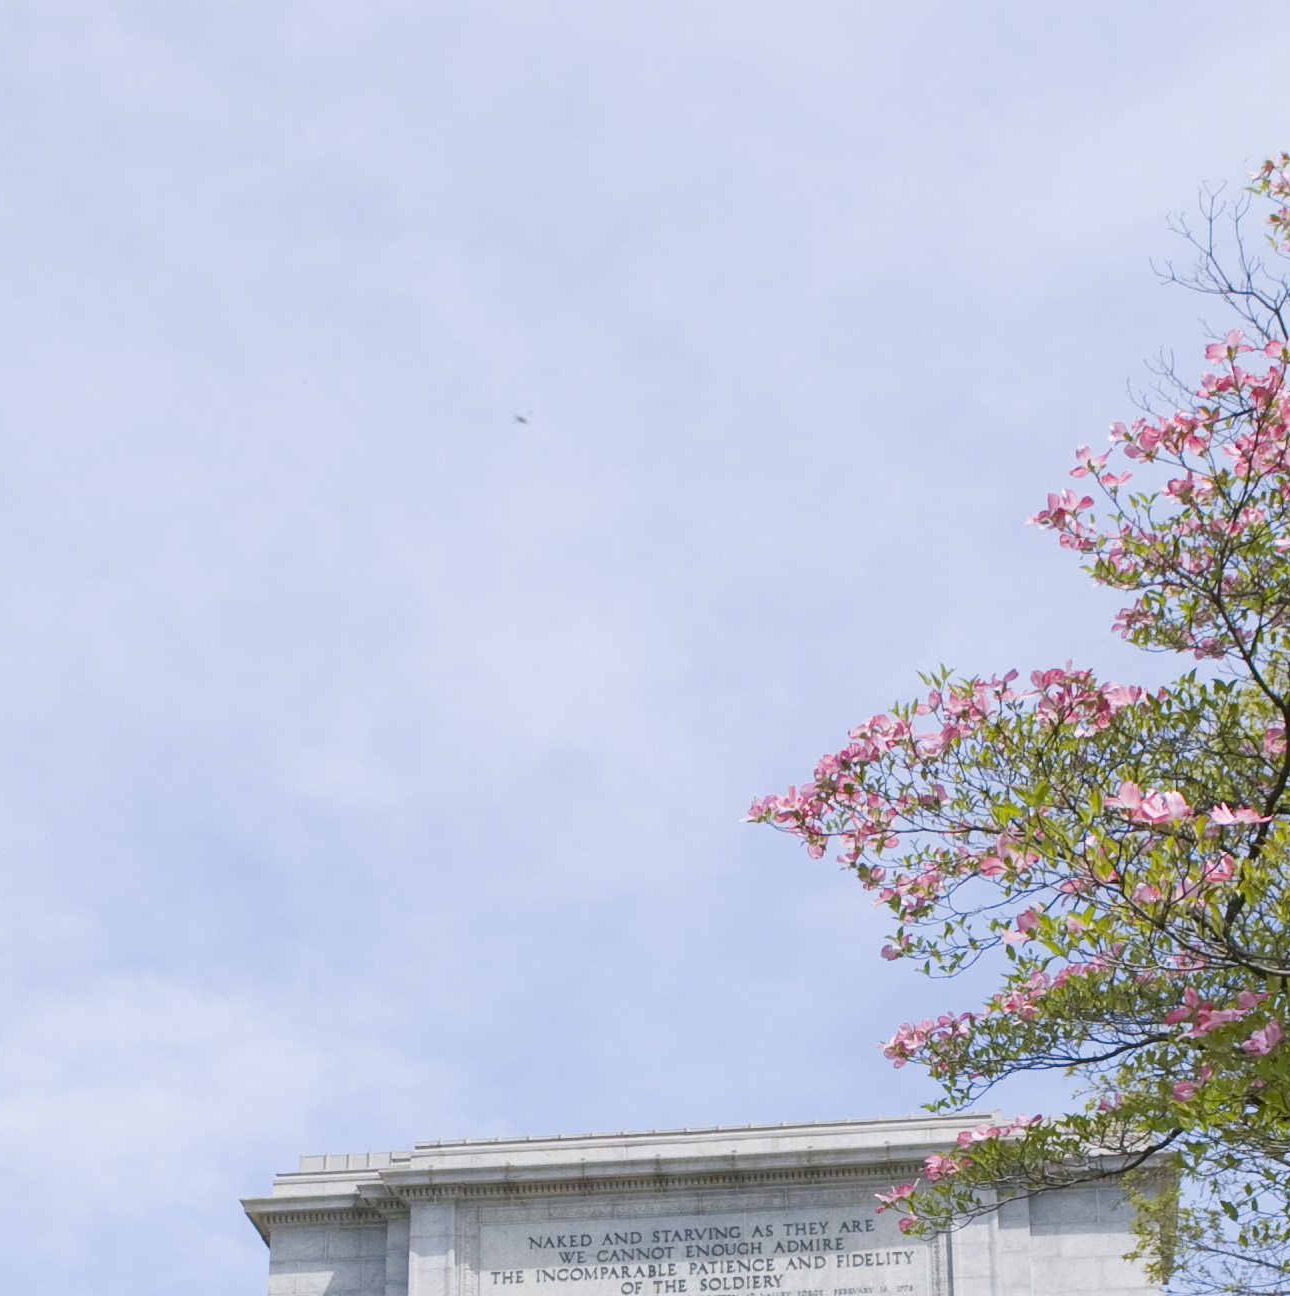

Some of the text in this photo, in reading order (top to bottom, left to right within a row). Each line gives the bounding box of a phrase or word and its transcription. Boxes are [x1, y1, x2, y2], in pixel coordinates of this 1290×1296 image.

[528, 1218, 876, 1250] NAKED AND STARVING AS THEY ARE
[558, 1237, 846, 1264] WE CANNOT ENOUGH ADMIRE
[490, 1250, 916, 1285] THE INCOMPARABLE PATIENCE AND FIDELITY
[620, 1273, 785, 1296] OF THE SOLDIERY
